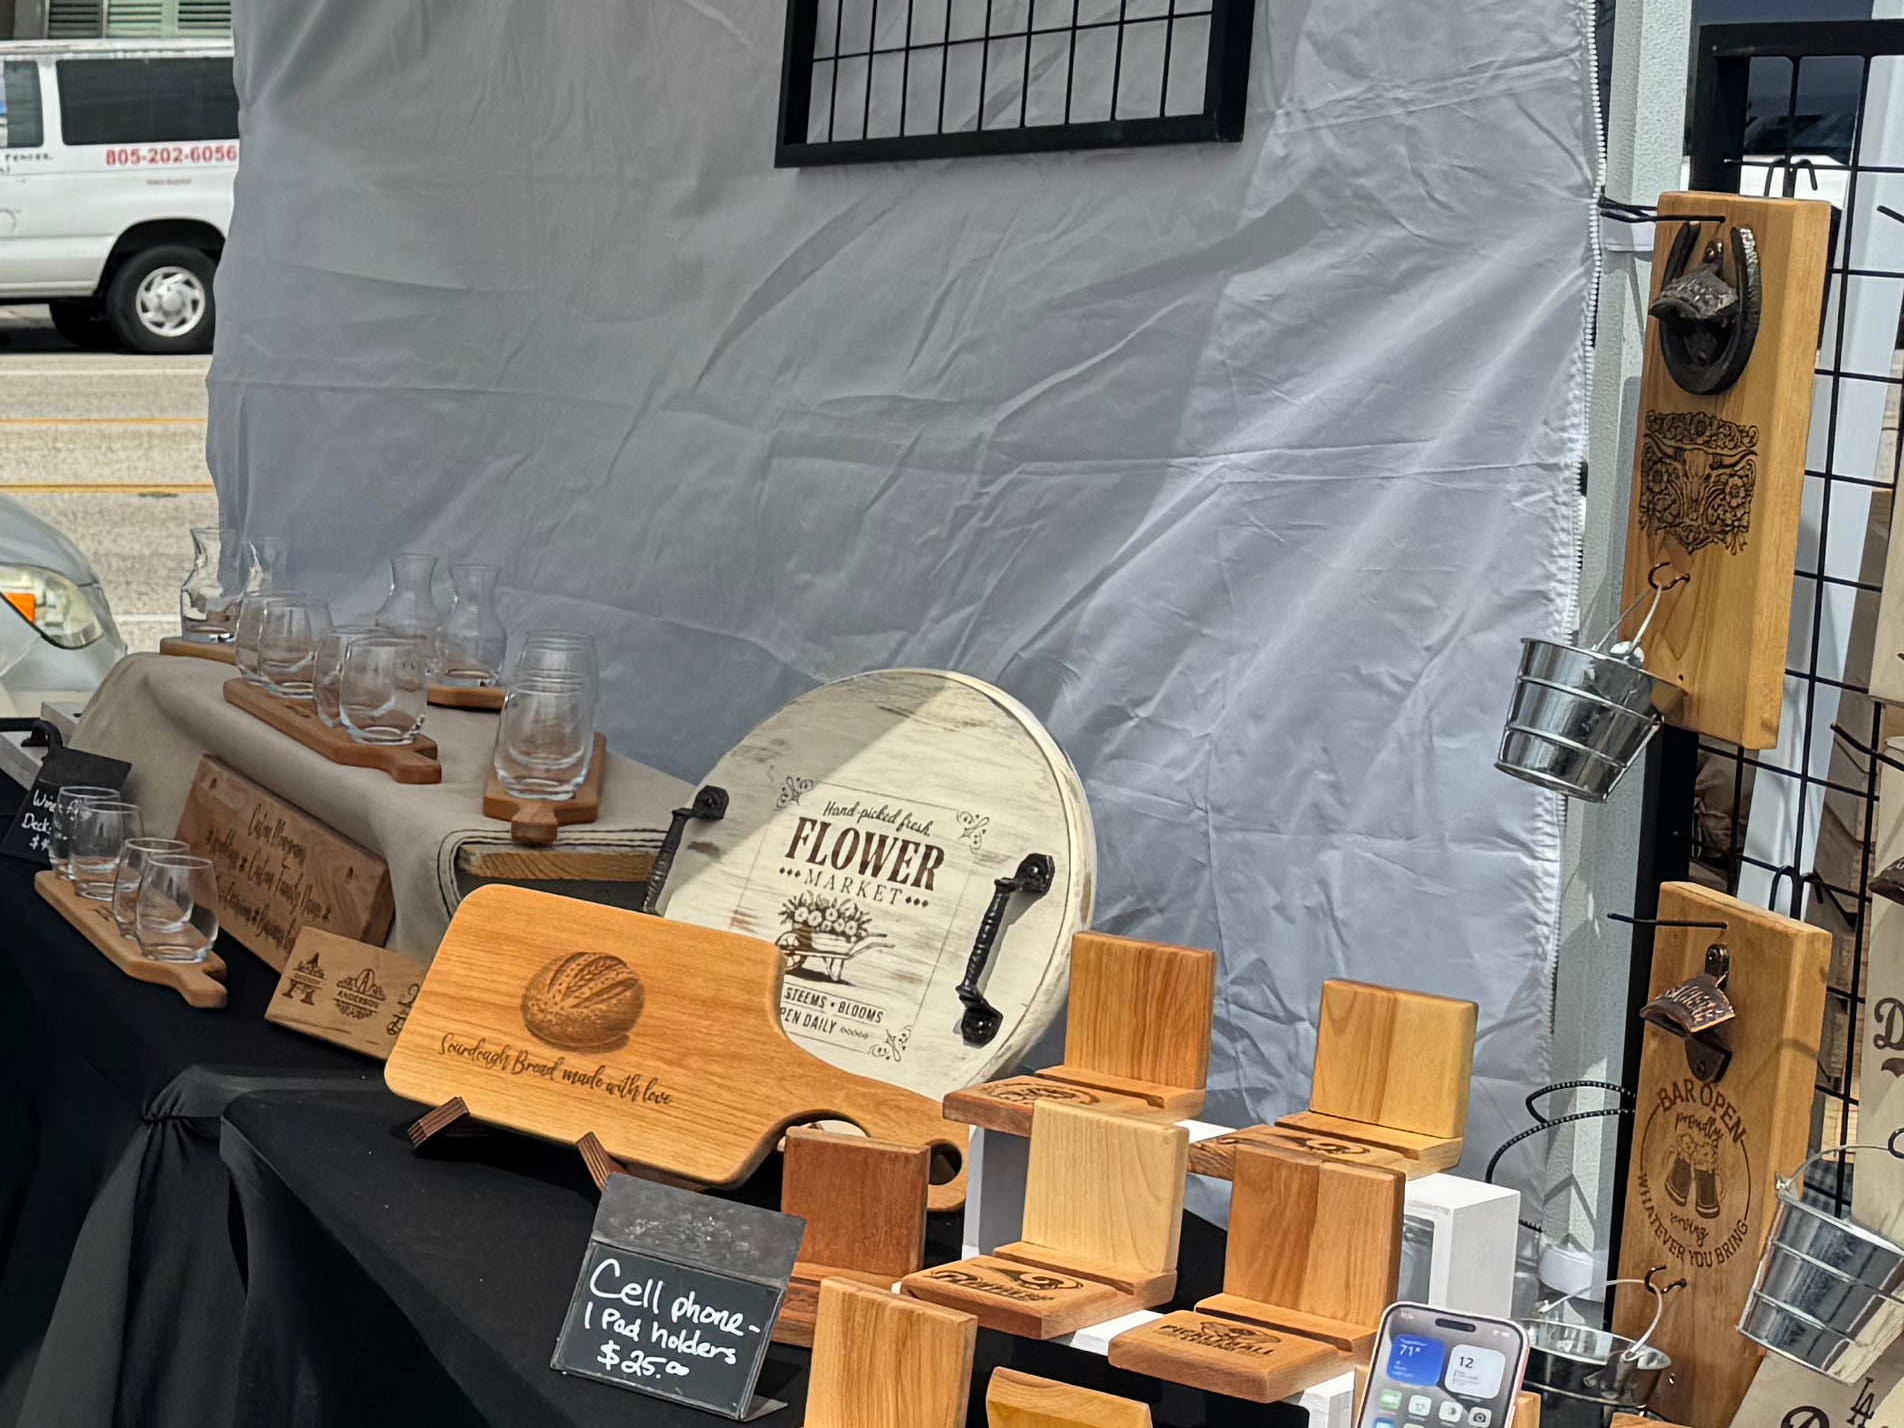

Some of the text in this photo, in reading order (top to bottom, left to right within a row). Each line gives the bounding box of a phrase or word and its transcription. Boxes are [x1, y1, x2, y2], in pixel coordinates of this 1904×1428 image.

[106, 145, 237, 165] 805-202-6056
[823, 801, 934, 837] Hand-picked fresh.
[785, 817, 944, 891] FLOWER
[804, 868, 902, 906] MARKET
[780, 1007, 838, 1034] PEN DAILY
[784, 987, 884, 1024] STEEMS BLOOMS
[438, 1032, 672, 1105] Sourdough Bread made with love
[1656, 1078, 1746, 1144] BAR OPEN
[1675, 1112, 1724, 1148] proudly
[1638, 1173, 1748, 1268] WHATEVER YOU BRING
[1669, 1212, 1709, 1248] serving
[589, 1258, 664, 1314] Cell
[602, 1309, 641, 1341] Pad
[652, 1322, 737, 1365] holders
[1459, 1356, 1475, 1368] 12
